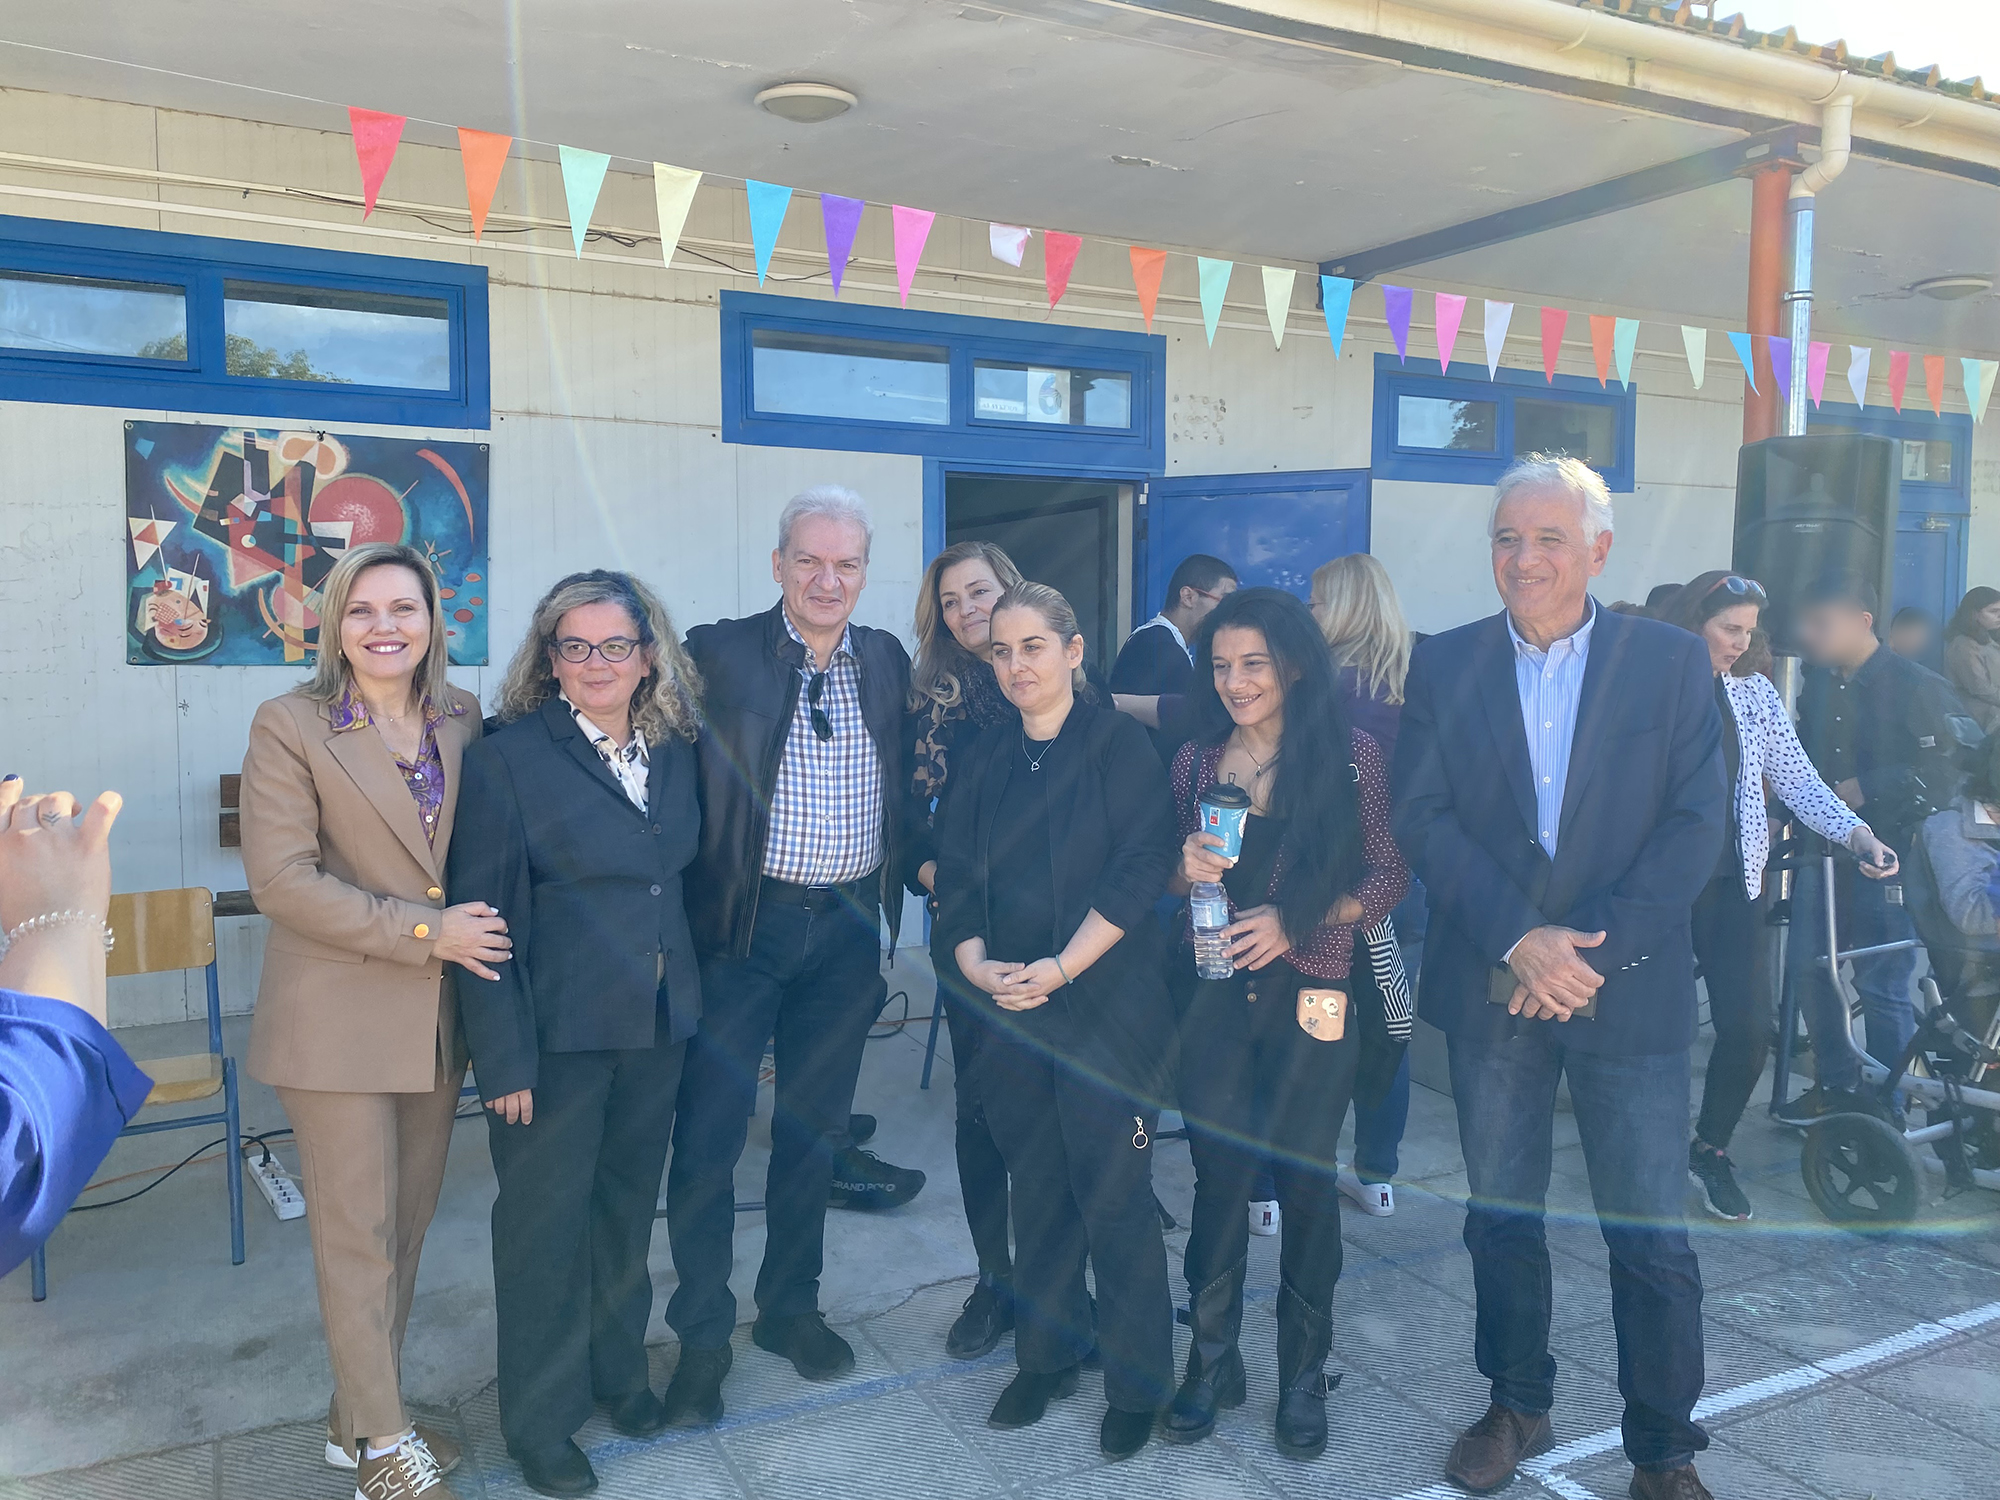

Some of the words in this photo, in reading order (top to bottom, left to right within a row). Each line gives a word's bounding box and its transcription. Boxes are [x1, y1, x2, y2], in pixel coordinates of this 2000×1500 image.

[1038, 373, 1063, 416] 6
[831, 1179, 865, 1192] GRAND
[867, 1183, 895, 1192] POO
